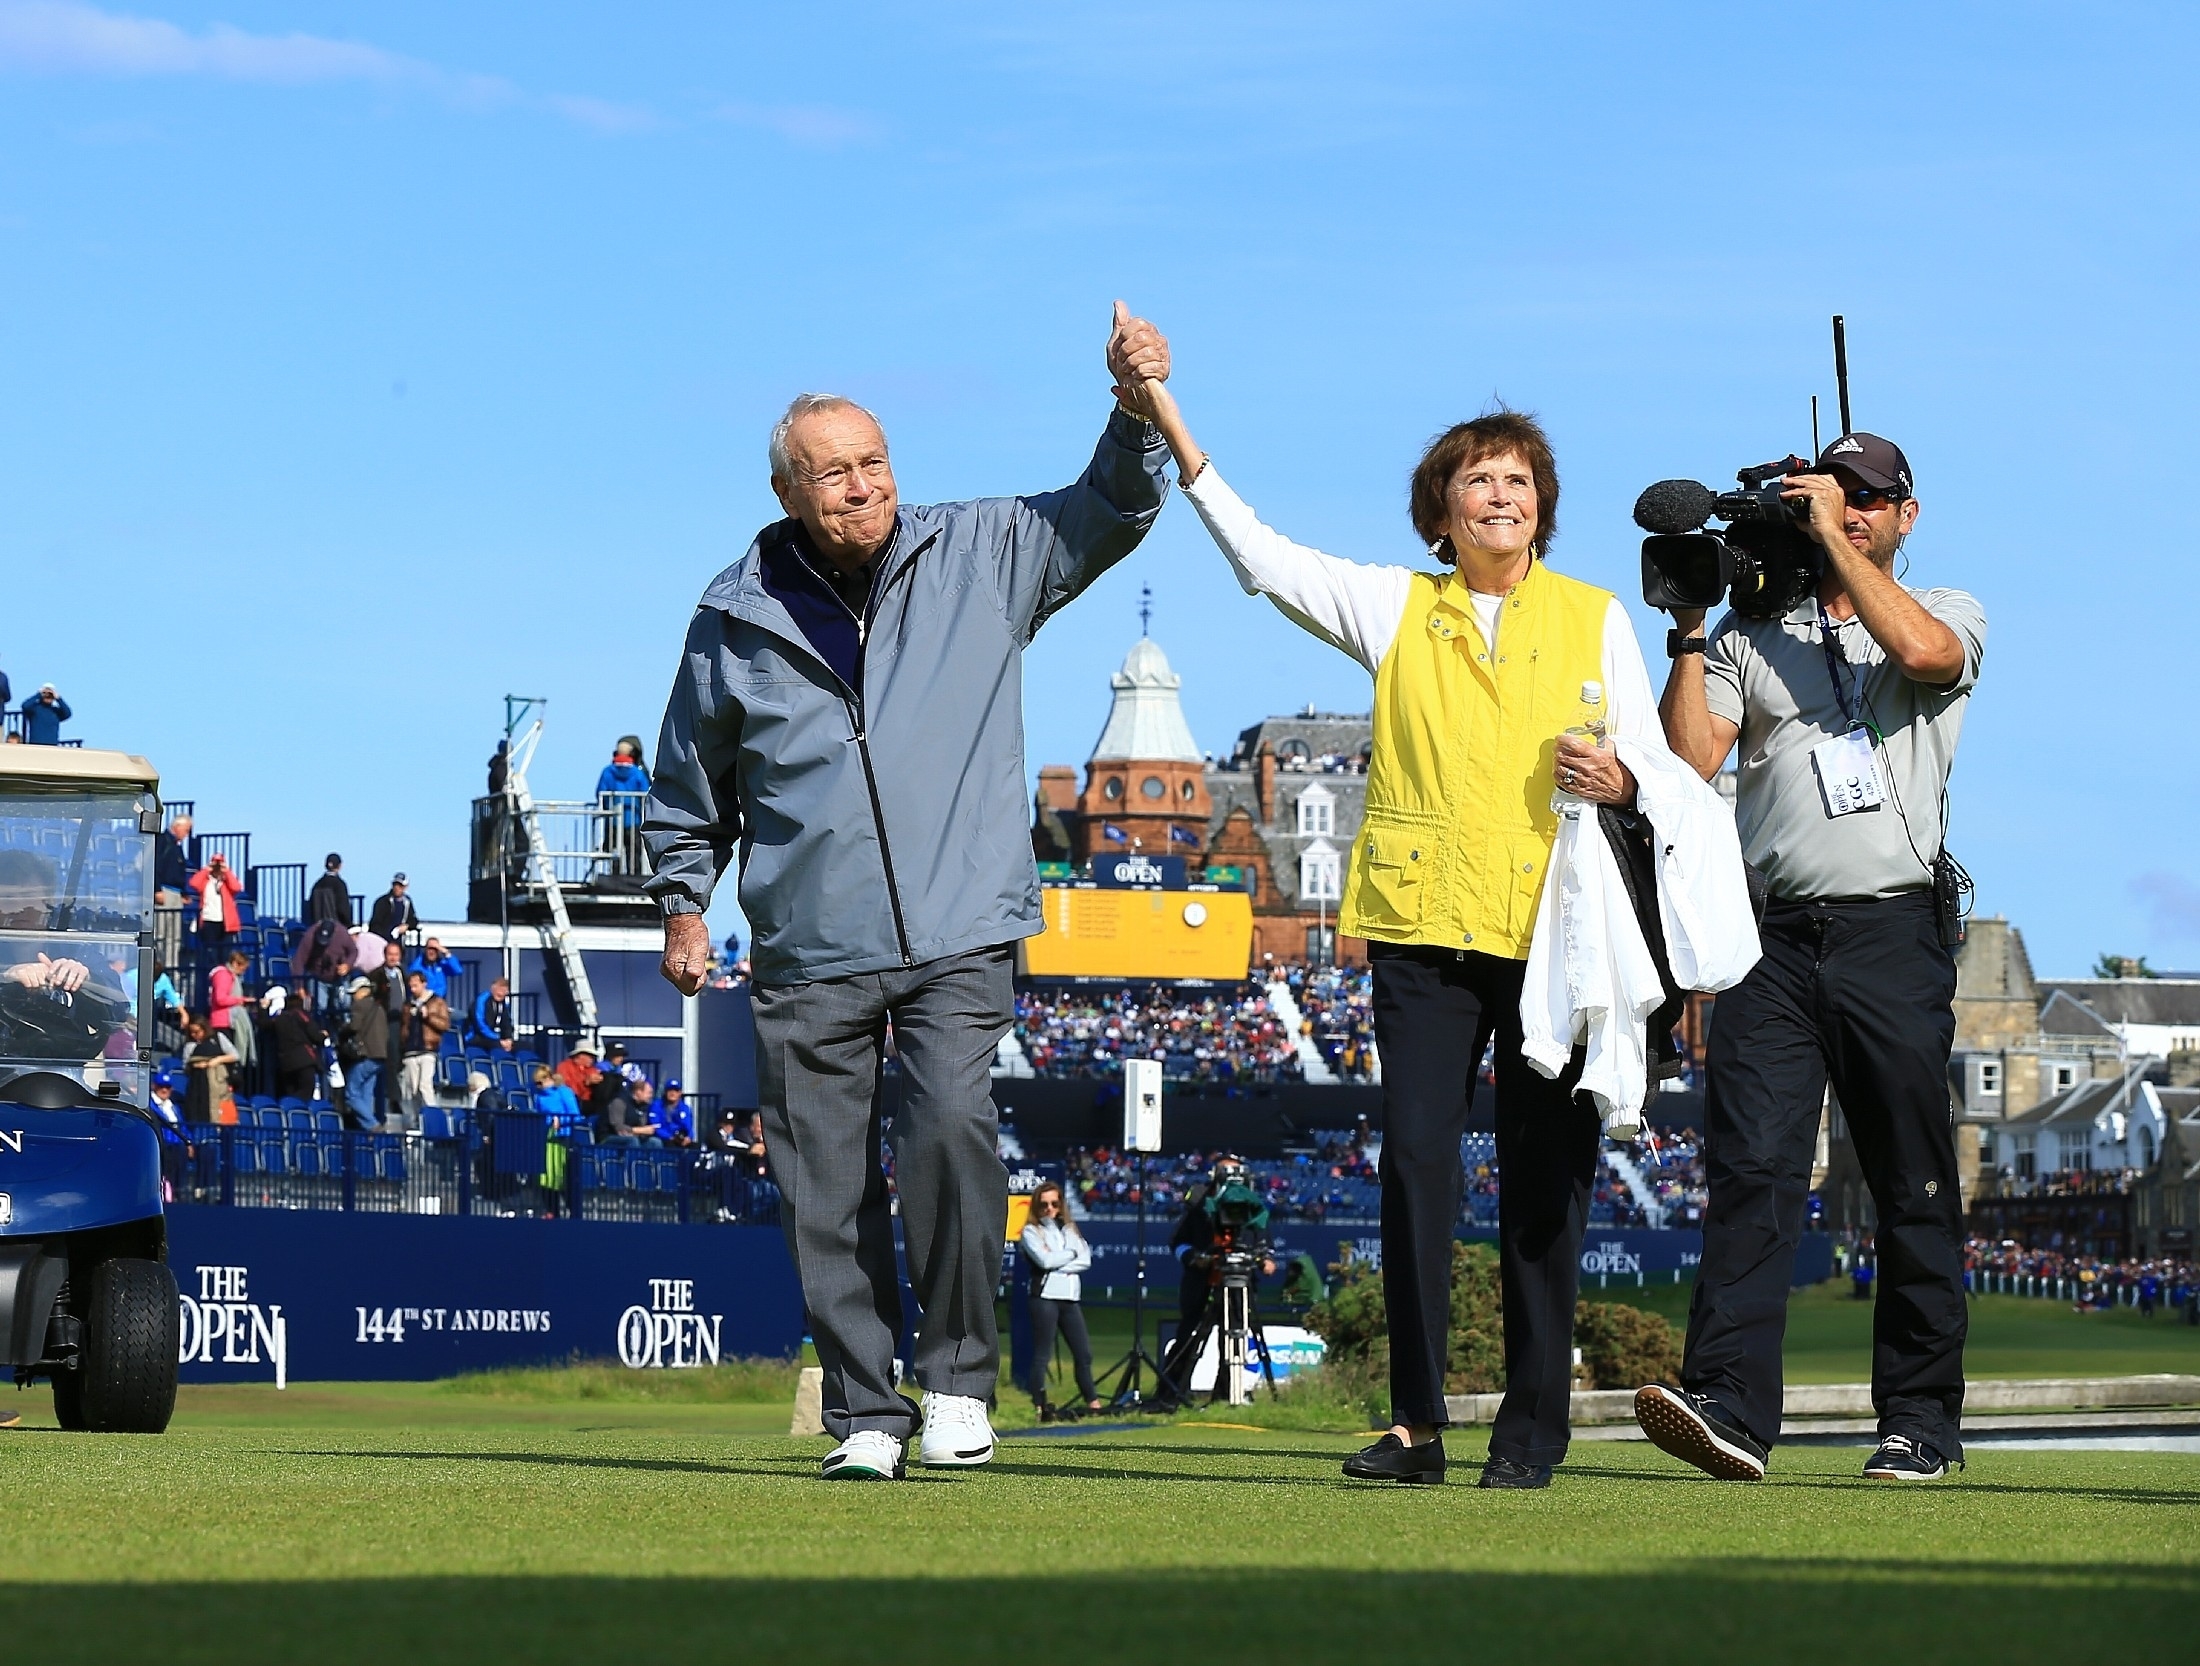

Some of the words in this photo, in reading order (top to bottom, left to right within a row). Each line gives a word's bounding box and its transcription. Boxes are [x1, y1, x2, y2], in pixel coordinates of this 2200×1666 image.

[1832, 443, 1864, 455] adidas
[1834, 784, 1848, 812] OPEN
[1847, 776, 1865, 810] CGC
[1114, 863, 1163, 883] OPEN
[1599, 1241, 1624, 1253] THE
[1581, 1250, 1640, 1273] OPEN
[195, 1265, 249, 1301] THE
[648, 1278, 695, 1311] THE
[421, 1308, 448, 1331] ST
[450, 1309, 551, 1333] ANDREWS
[617, 1304, 724, 1369] OPEN
